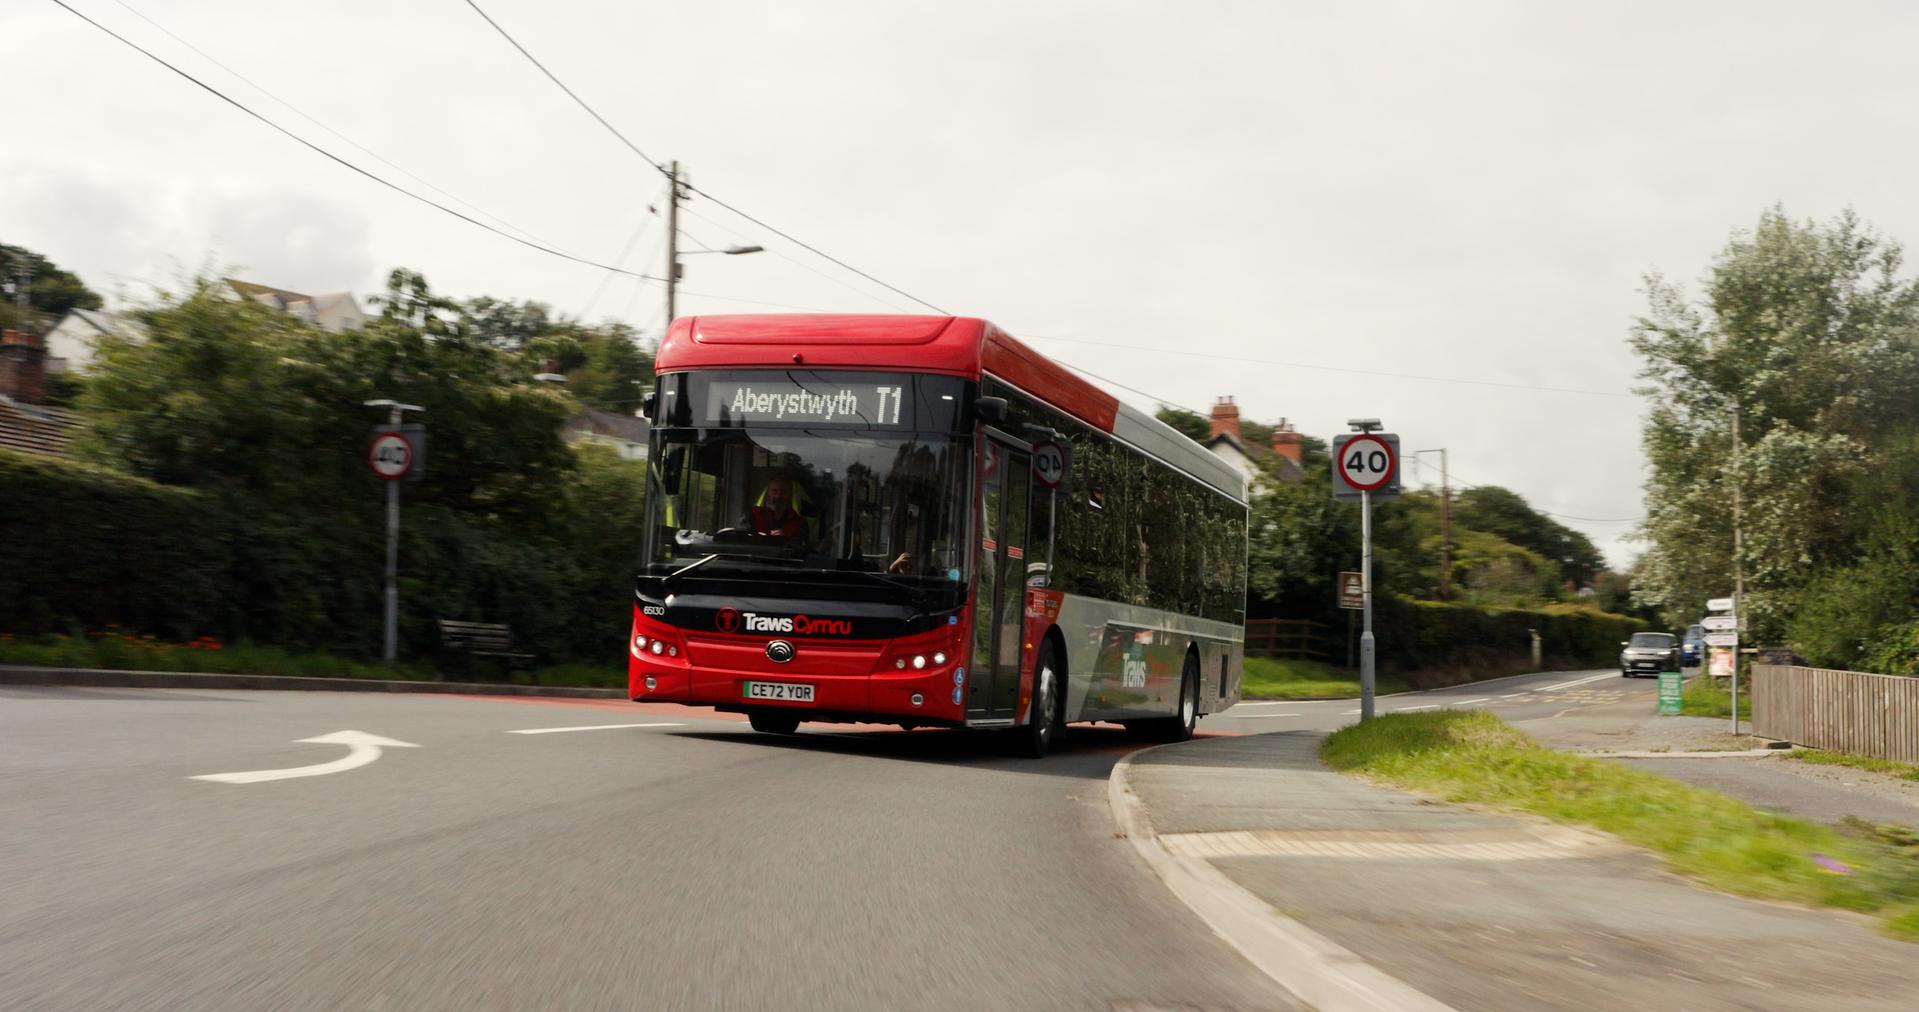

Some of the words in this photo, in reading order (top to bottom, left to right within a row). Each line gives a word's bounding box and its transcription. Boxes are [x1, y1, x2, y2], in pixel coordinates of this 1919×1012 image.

[731, 387, 857, 420] Aberystwyth
[877, 386, 902, 424] T1
[1346, 451, 1387, 473] 40
[742, 612, 852, 635] TrawsCymru
[751, 683, 784, 698] CE72
[787, 685, 812, 700] YOR
